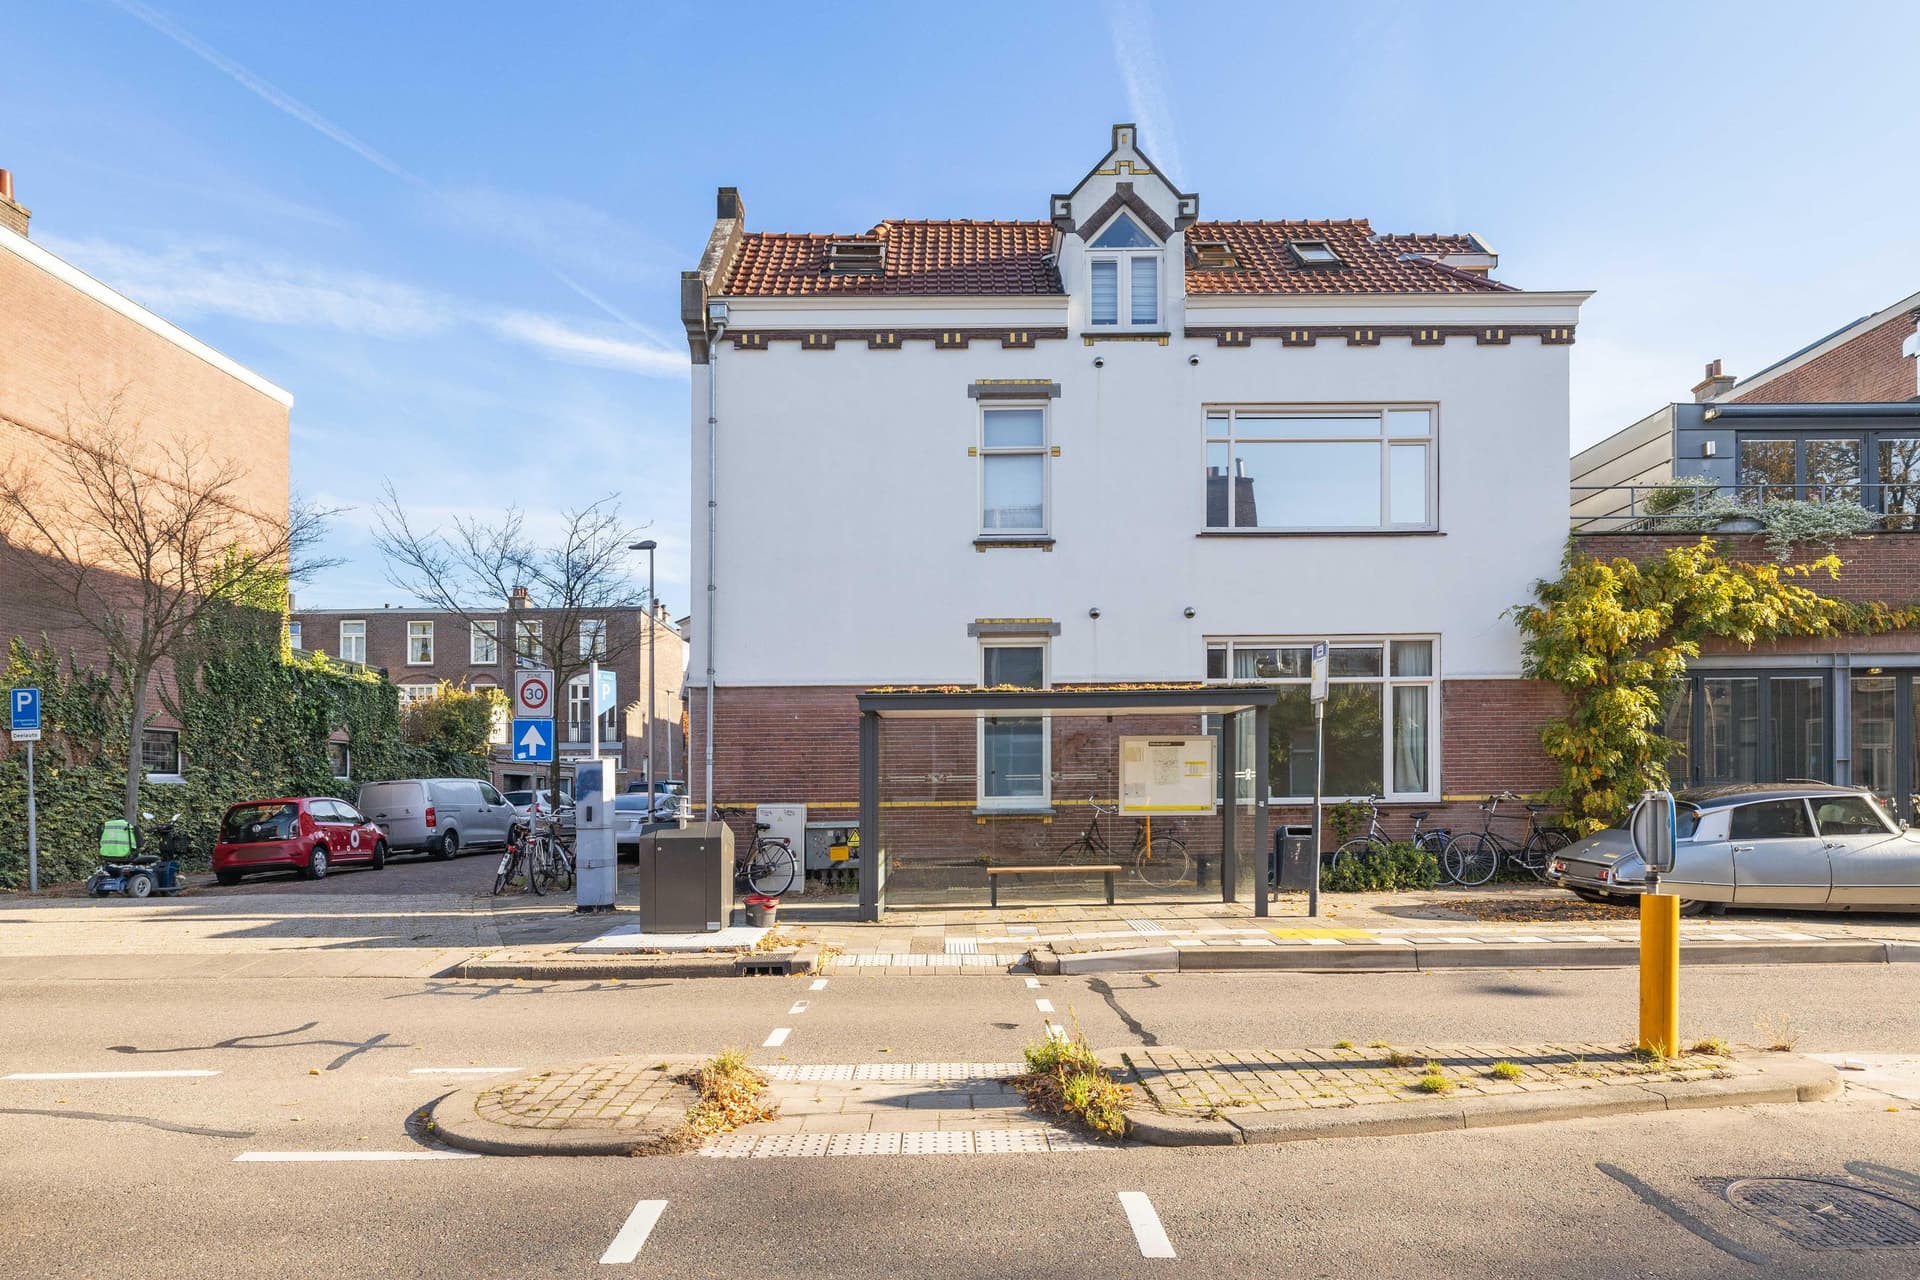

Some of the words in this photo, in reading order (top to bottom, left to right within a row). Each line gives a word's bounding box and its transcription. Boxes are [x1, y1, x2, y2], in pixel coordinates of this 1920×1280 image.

[526, 688, 543, 700] 30
[602, 684, 610, 700] P
[17, 692, 32, 712] P
